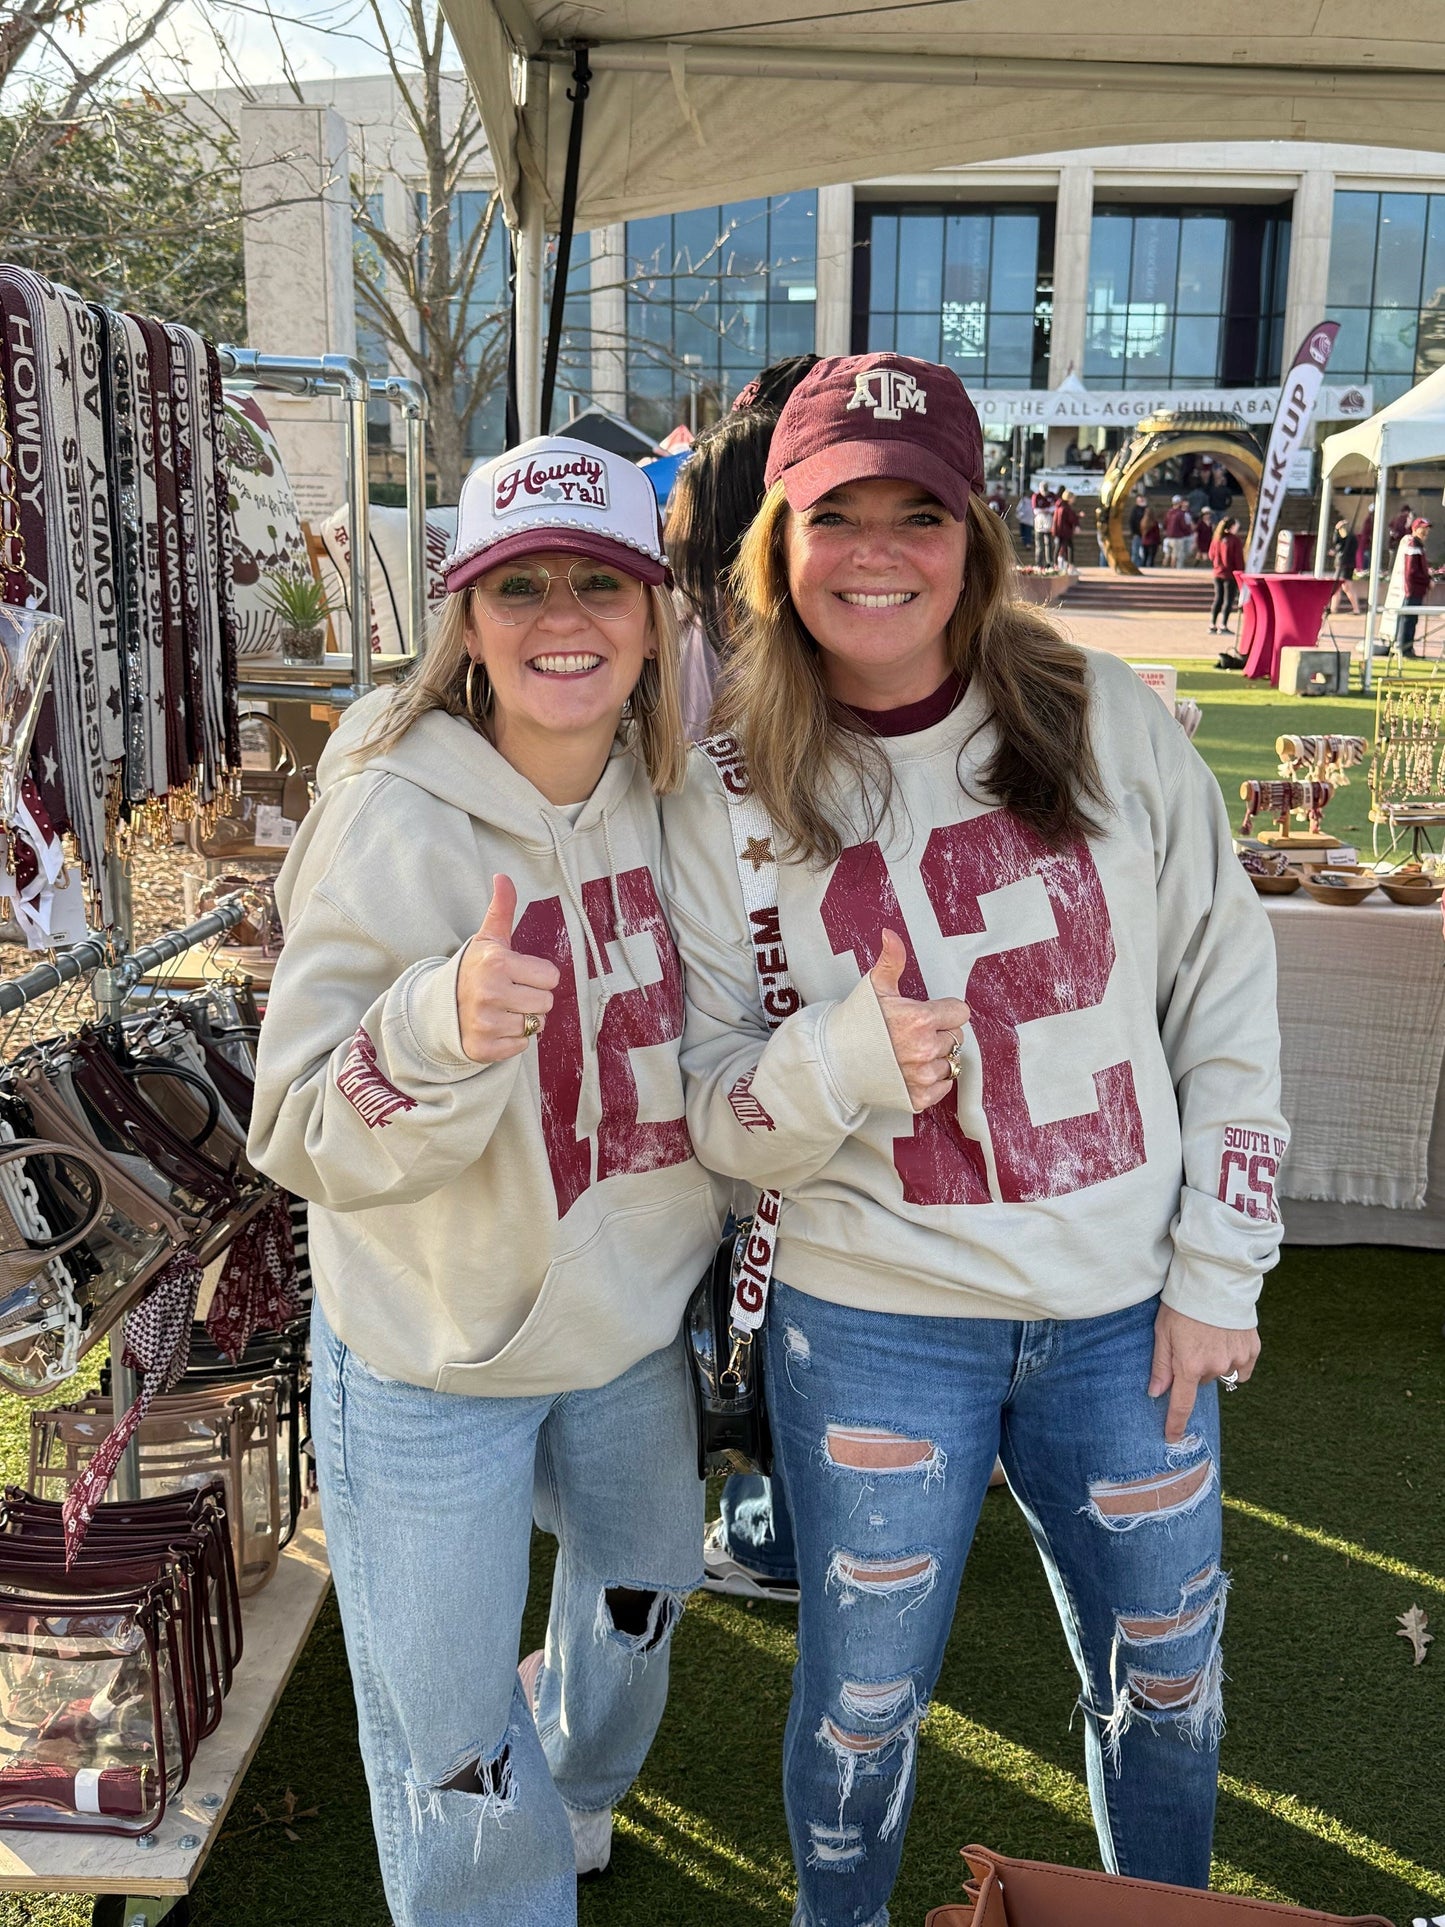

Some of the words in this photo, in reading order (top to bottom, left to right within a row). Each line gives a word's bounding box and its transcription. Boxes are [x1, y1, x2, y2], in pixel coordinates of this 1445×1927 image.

[9, 314, 43, 517] HOWDY
[65, 291, 101, 420] AGS!
[168, 329, 192, 450] AGGIES
[199, 367, 214, 445] AGS!
[1009, 401, 1045, 416] THE
[135, 351, 157, 482] AGGIES
[156, 390, 174, 473] AGS!
[212, 401, 229, 477] AGS!
[62, 436, 89, 605] AGGIES
[494, 456, 604, 510] Howdy
[558, 481, 608, 507] Y'all
[87, 457, 116, 651] HOWDY
[162, 505, 182, 627] HOWDY
[219, 509, 237, 623] HOWDY
[511, 866, 696, 1221] 12
[819, 805, 1148, 1205] 12
[1224, 1126, 1270, 1154] SOUTH
